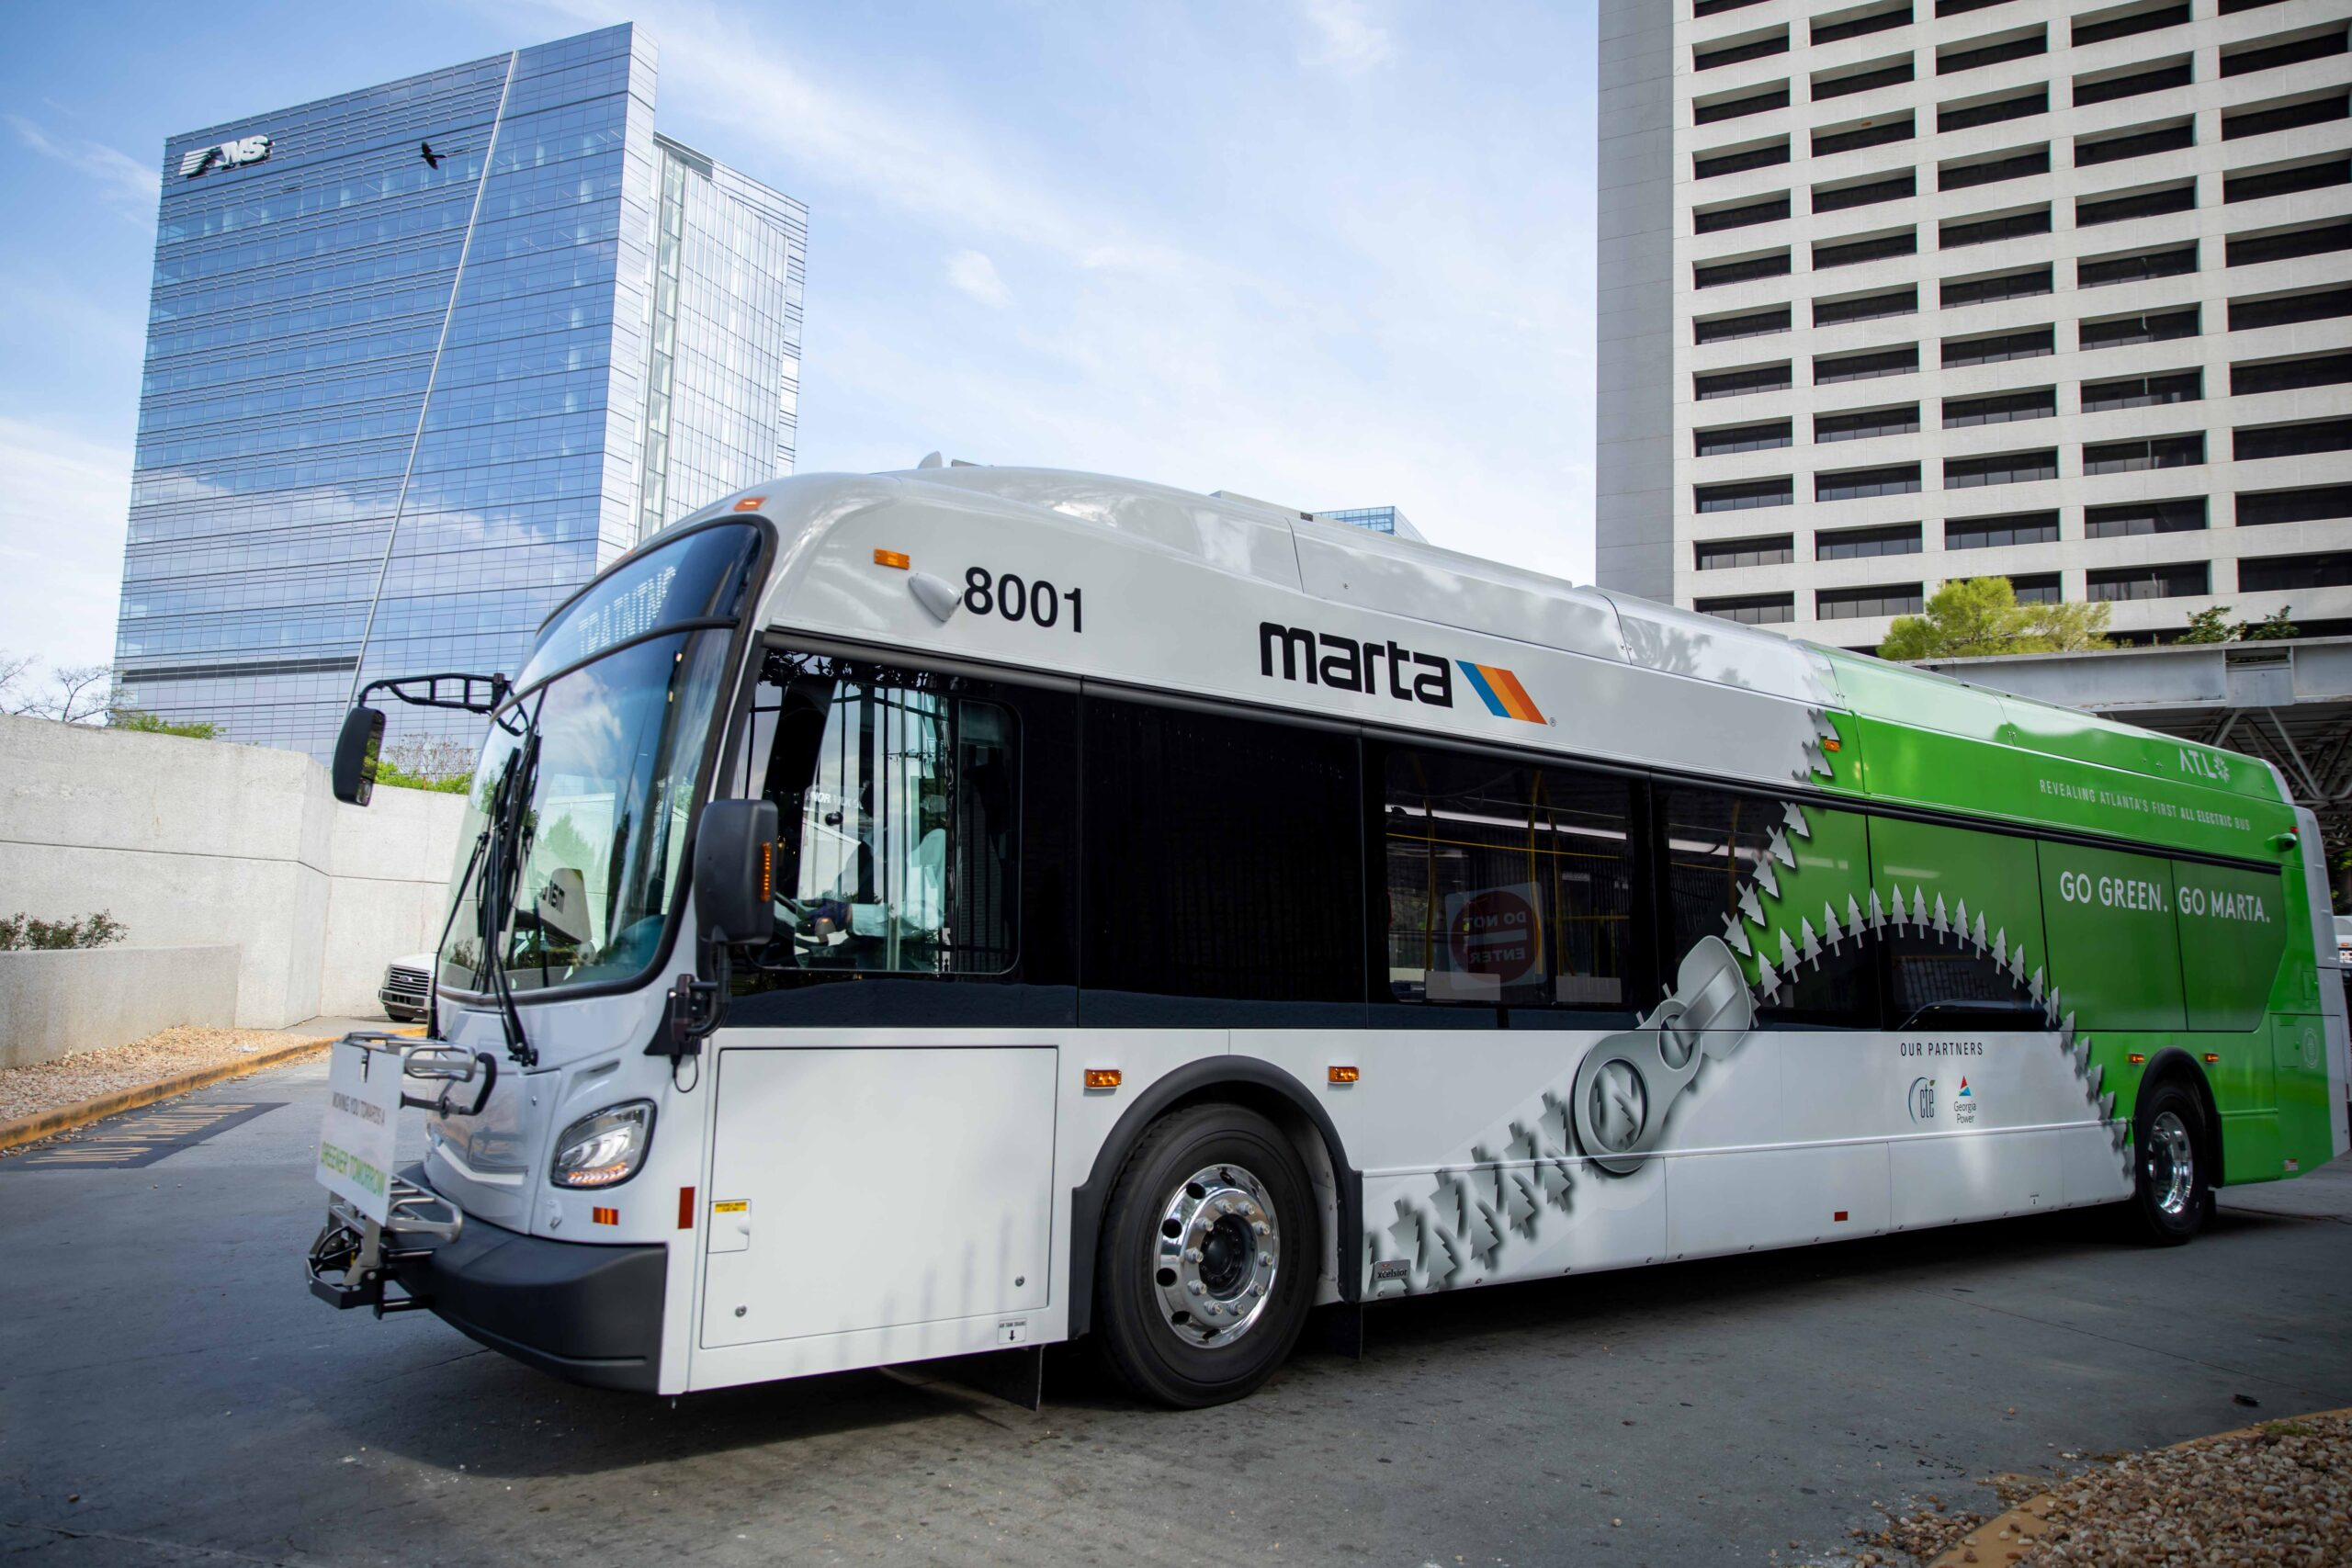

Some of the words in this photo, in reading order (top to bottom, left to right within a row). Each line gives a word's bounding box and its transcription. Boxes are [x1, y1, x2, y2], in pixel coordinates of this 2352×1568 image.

[964, 566, 1082, 633] 8001
[1259, 621, 1453, 708] marta
[2178, 748, 2217, 779] ATL
[2039, 779, 2096, 803] REVEALING
[2099, 791, 2149, 813] ATLANTA'S
[2152, 801, 2177, 818] FIRST
[2180, 807, 2195, 821] ALL
[2197, 809, 2233, 828] ELECTRIC
[2234, 817, 2251, 831] BUS
[2060, 871, 2092, 904] GO
[2098, 875, 2168, 913] GREEN.
[2178, 886, 2205, 916] GO
[2211, 890, 2270, 923] MARTA.
[1900, 1043, 1922, 1056] OUR
[1928, 1042, 1983, 1056] PARTNERS
[1953, 1101, 1977, 1114] Georgia
[1956, 1114, 1975, 1123] Power
[1377, 1269, 1408, 1279] xcelsior
